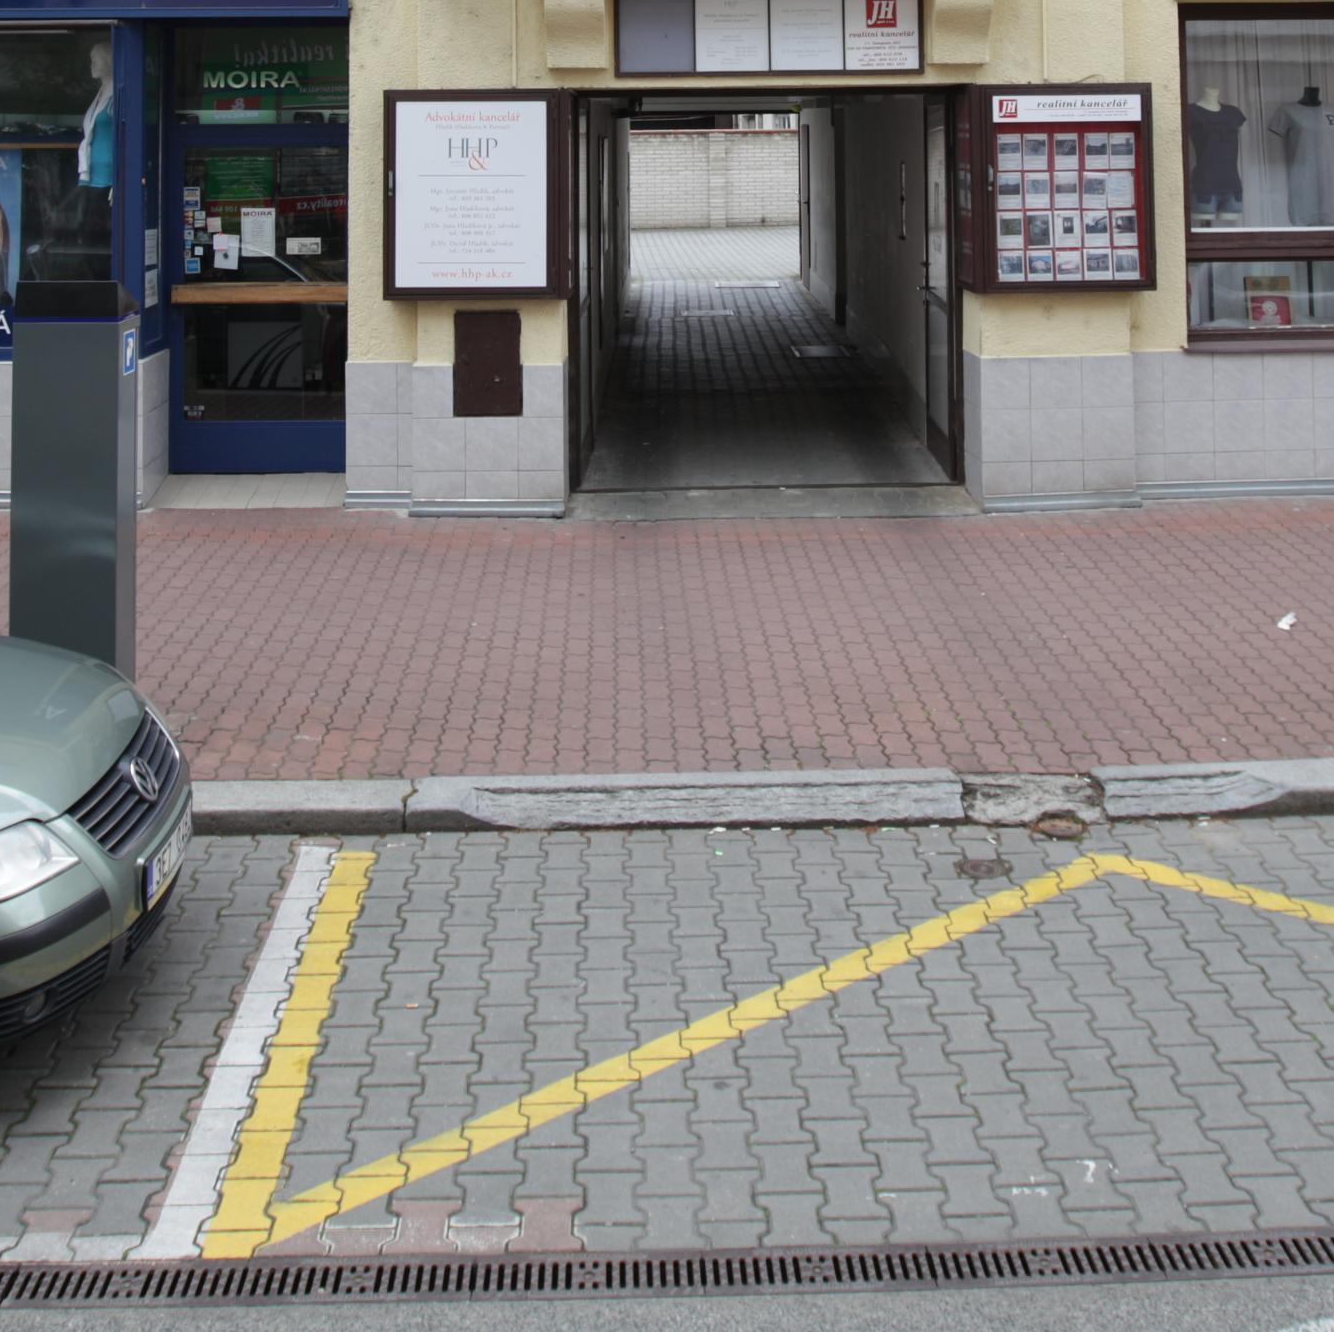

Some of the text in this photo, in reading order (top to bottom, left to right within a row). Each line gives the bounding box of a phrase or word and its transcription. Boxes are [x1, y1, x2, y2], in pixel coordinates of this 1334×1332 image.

[1080, 99, 1128, 108] kancelář
[425, 111, 520, 122] Advokátní kancelář
